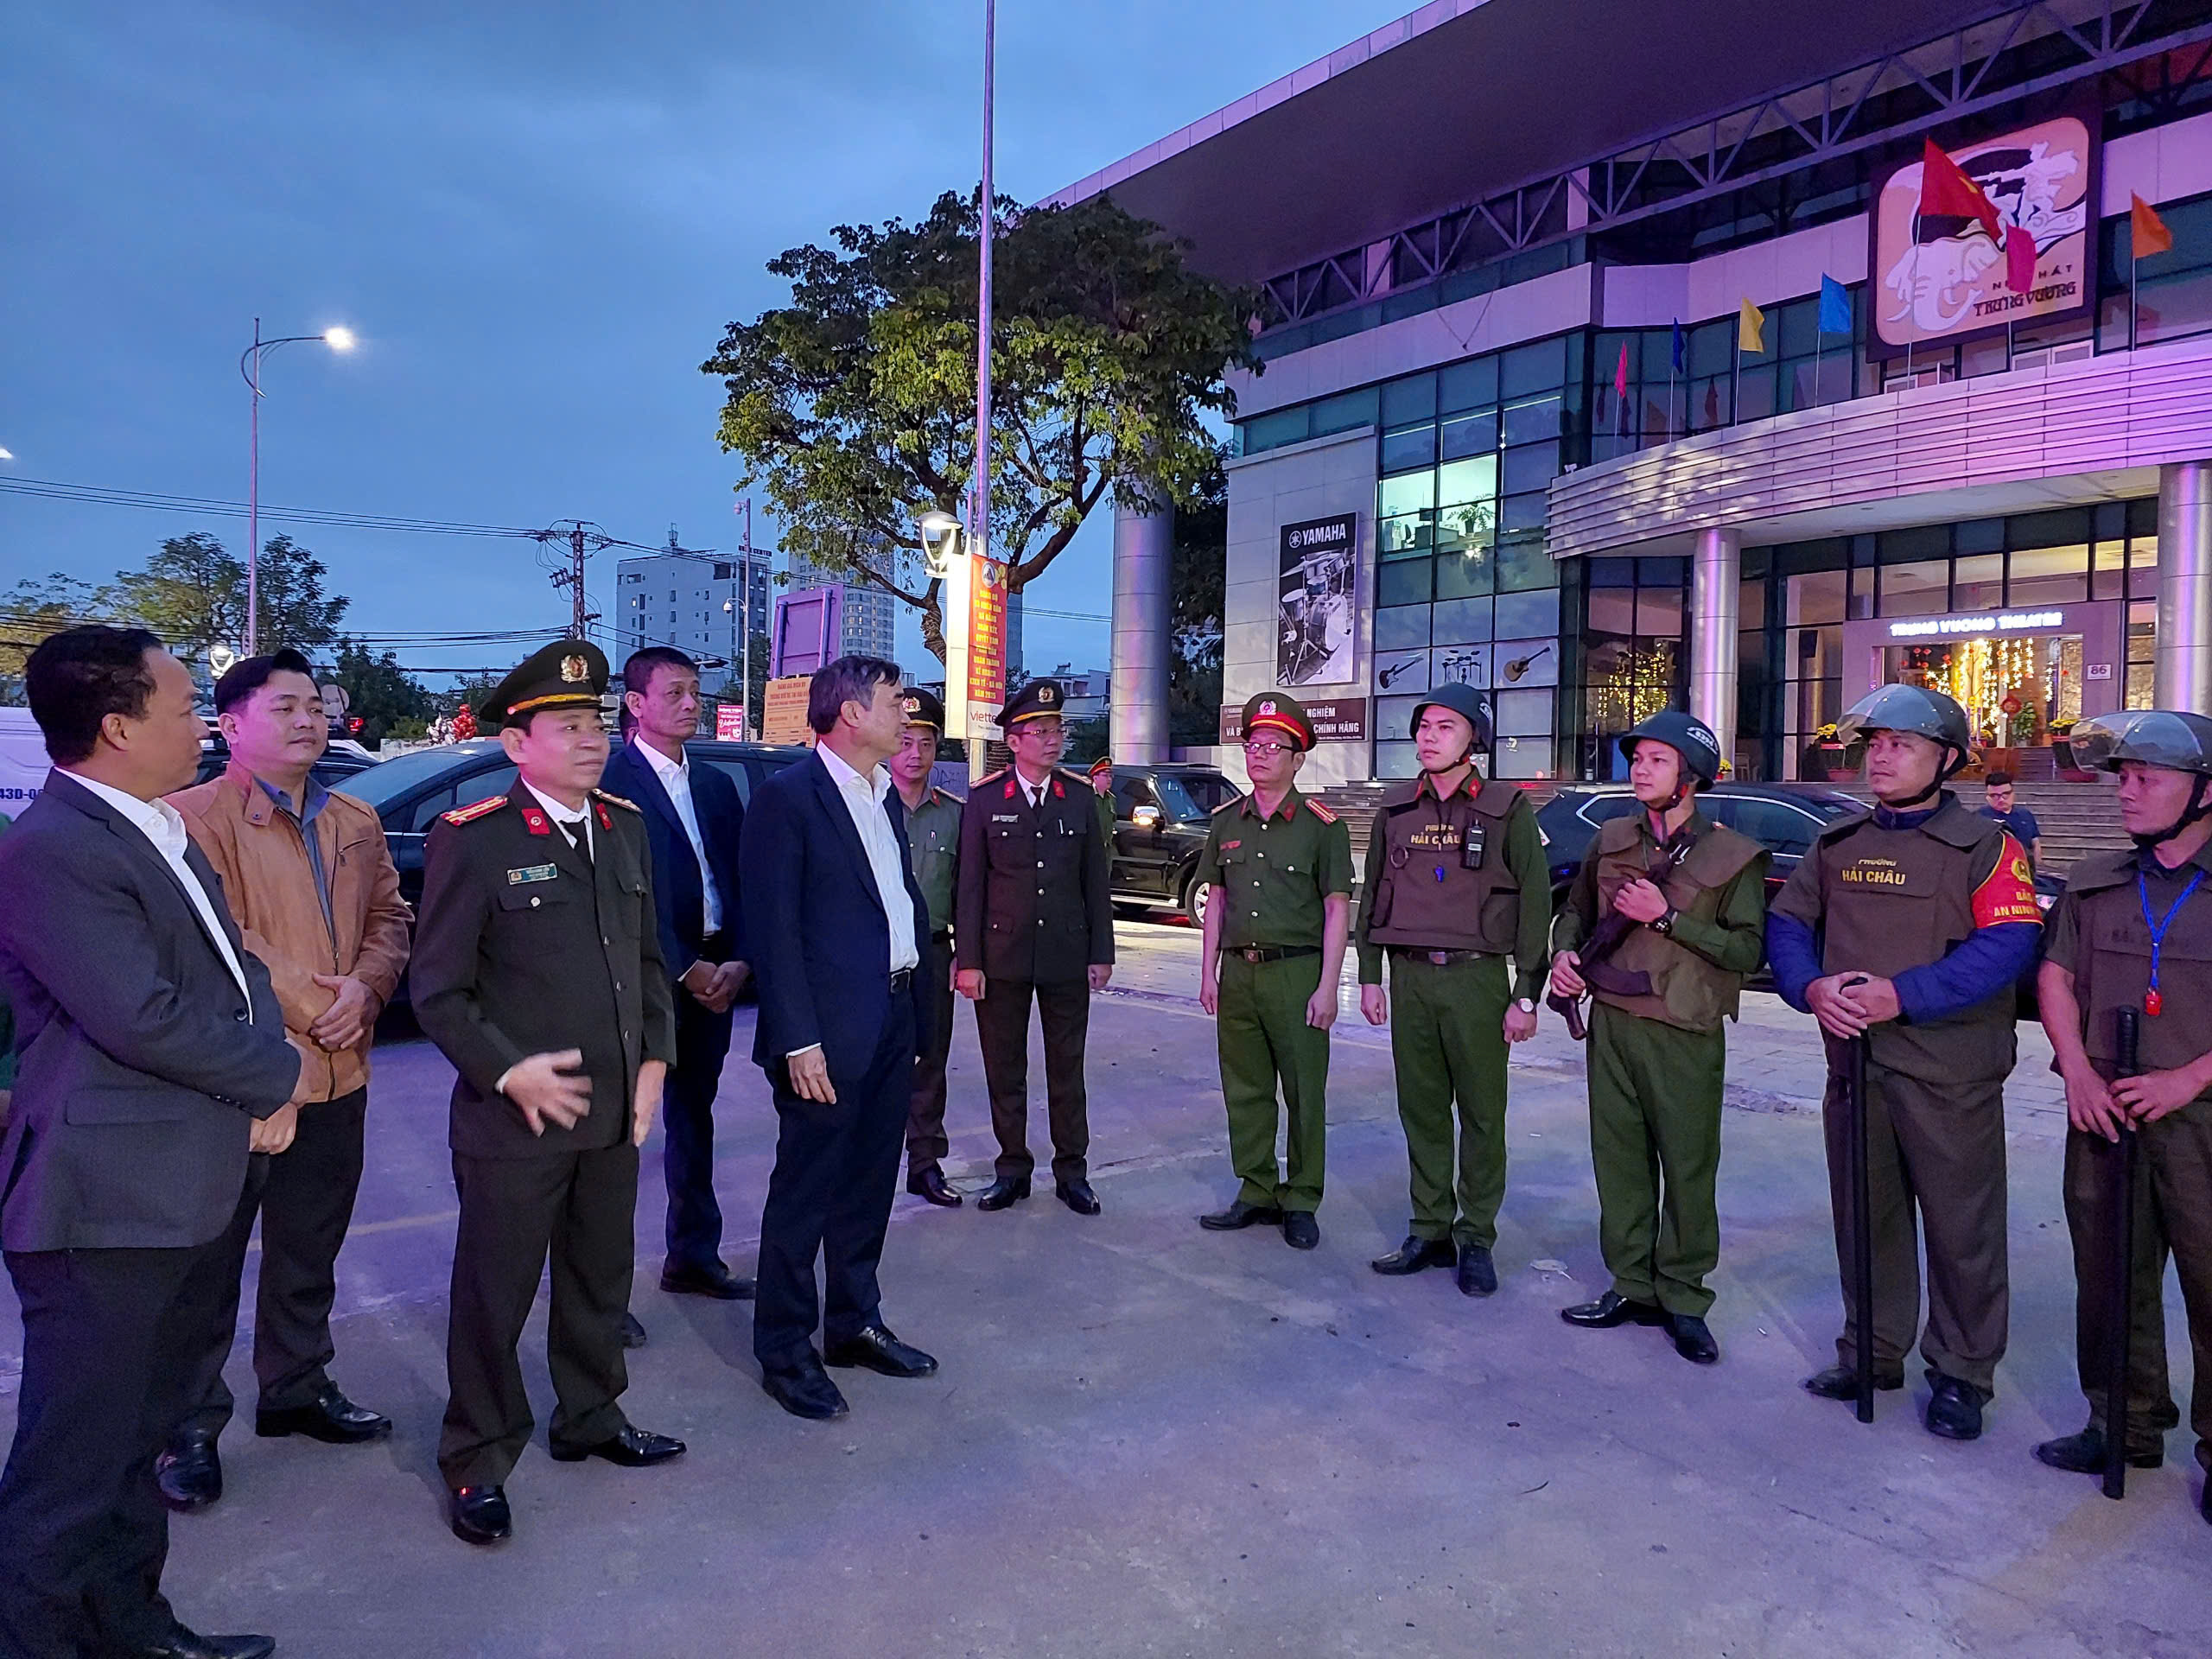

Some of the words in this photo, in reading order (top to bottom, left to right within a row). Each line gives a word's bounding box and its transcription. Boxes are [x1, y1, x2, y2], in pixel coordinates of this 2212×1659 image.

[1302, 524, 1346, 546] YAMAHA
[2090, 665, 2107, 676] 86
[969, 711, 996, 723] viette
[1306, 704, 1336, 720] NGHIỆM
[1225, 725, 1236, 737] VÀ
[1313, 721, 1337, 734] CHÍNH
[0, 788, 44, 800] 43D-0
[1411, 831, 1429, 844] HẢI
[1841, 867, 1862, 882] HẢI
[1866, 870, 1906, 886] CHÂU
[1993, 906, 2010, 917] AN
